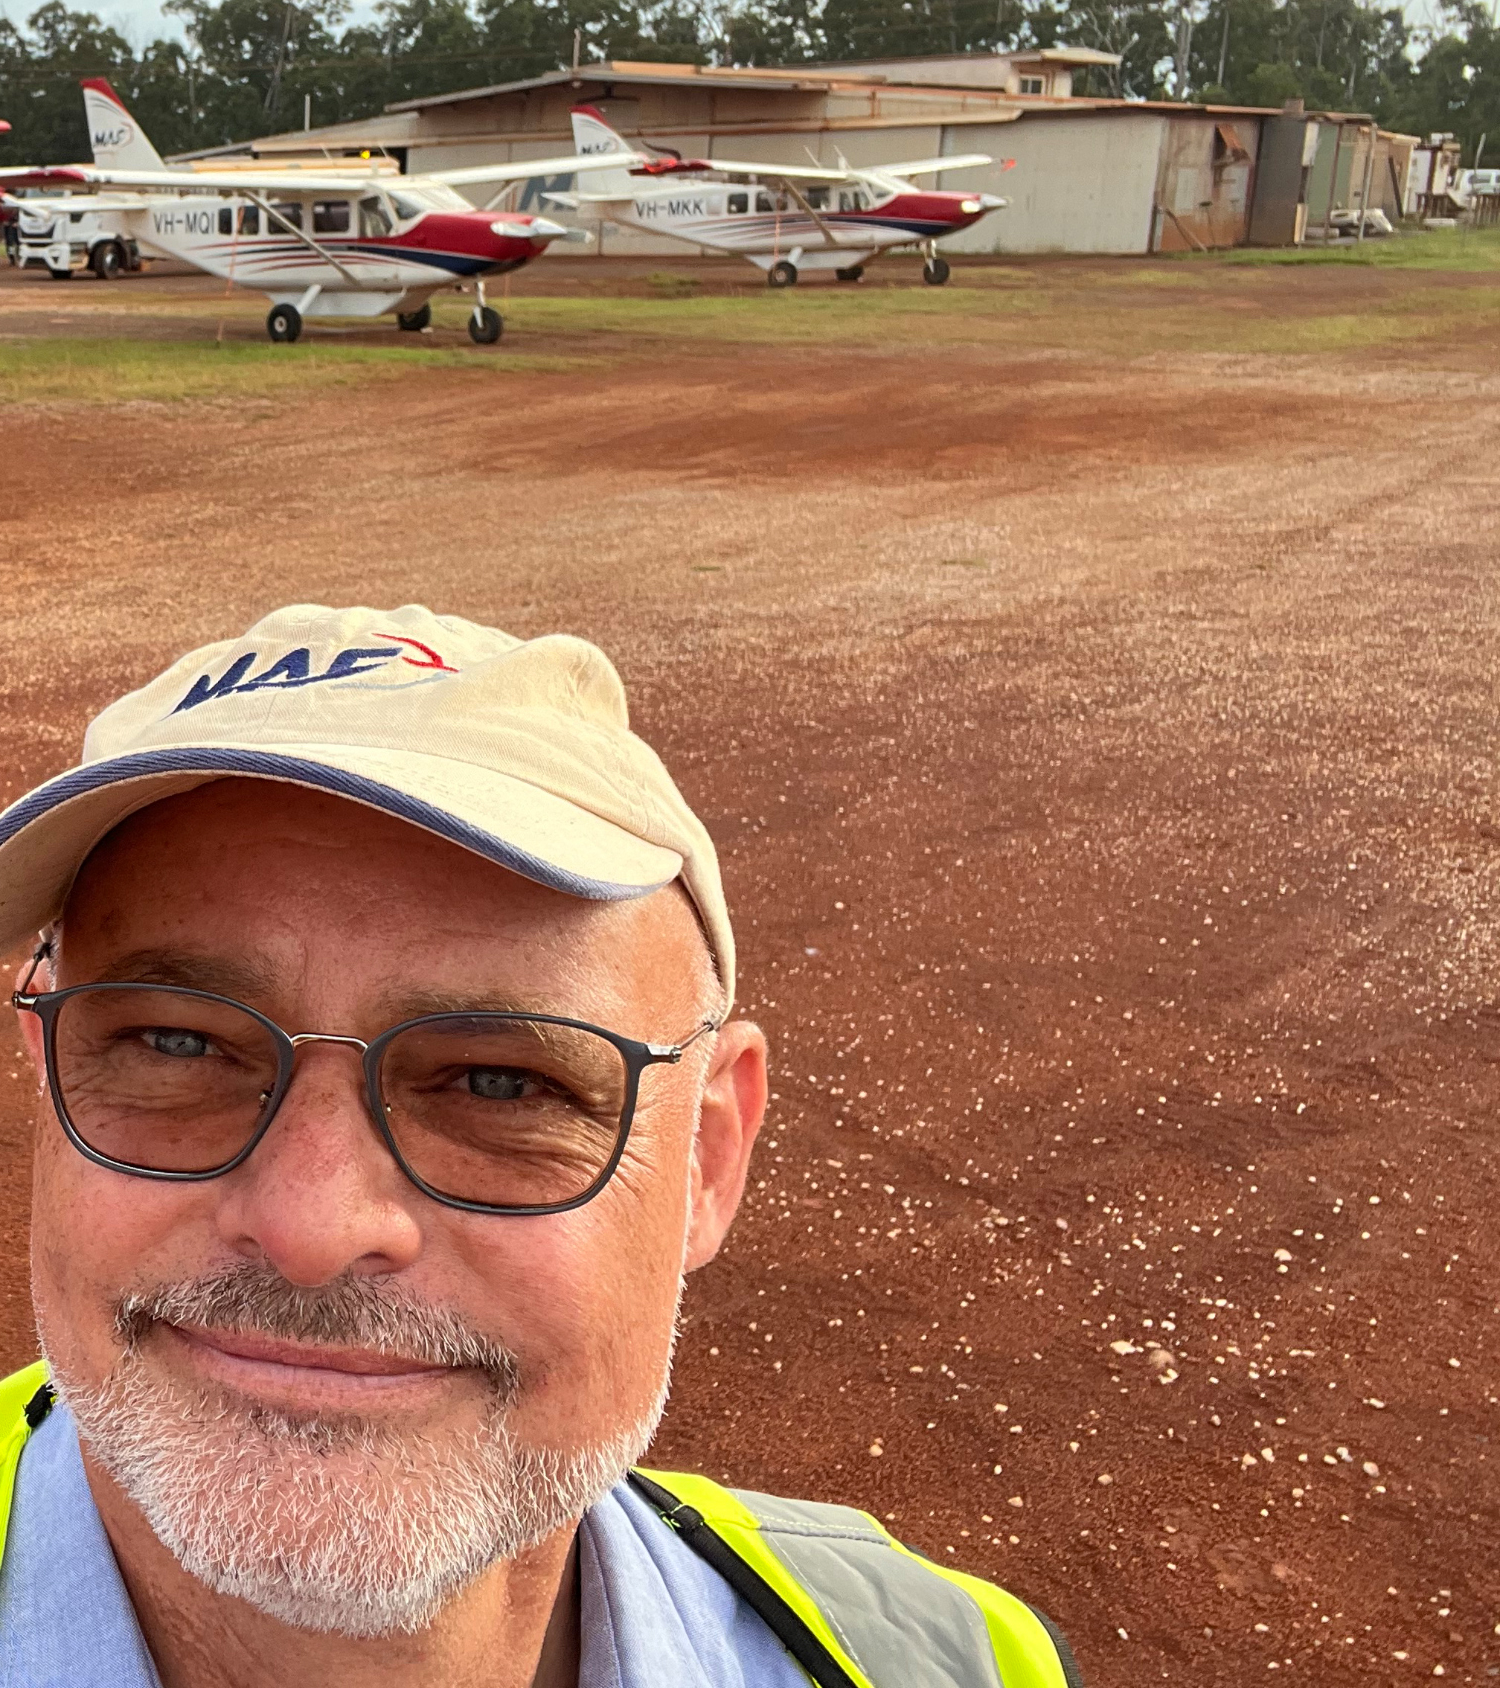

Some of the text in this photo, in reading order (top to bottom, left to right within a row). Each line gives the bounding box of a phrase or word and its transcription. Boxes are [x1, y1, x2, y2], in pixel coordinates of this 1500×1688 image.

[92, 128, 125, 147] MAF
[635, 200, 704, 219] VH-MKK
[153, 211, 215, 235] VH-MQI
[160, 647, 404, 722] MAF
